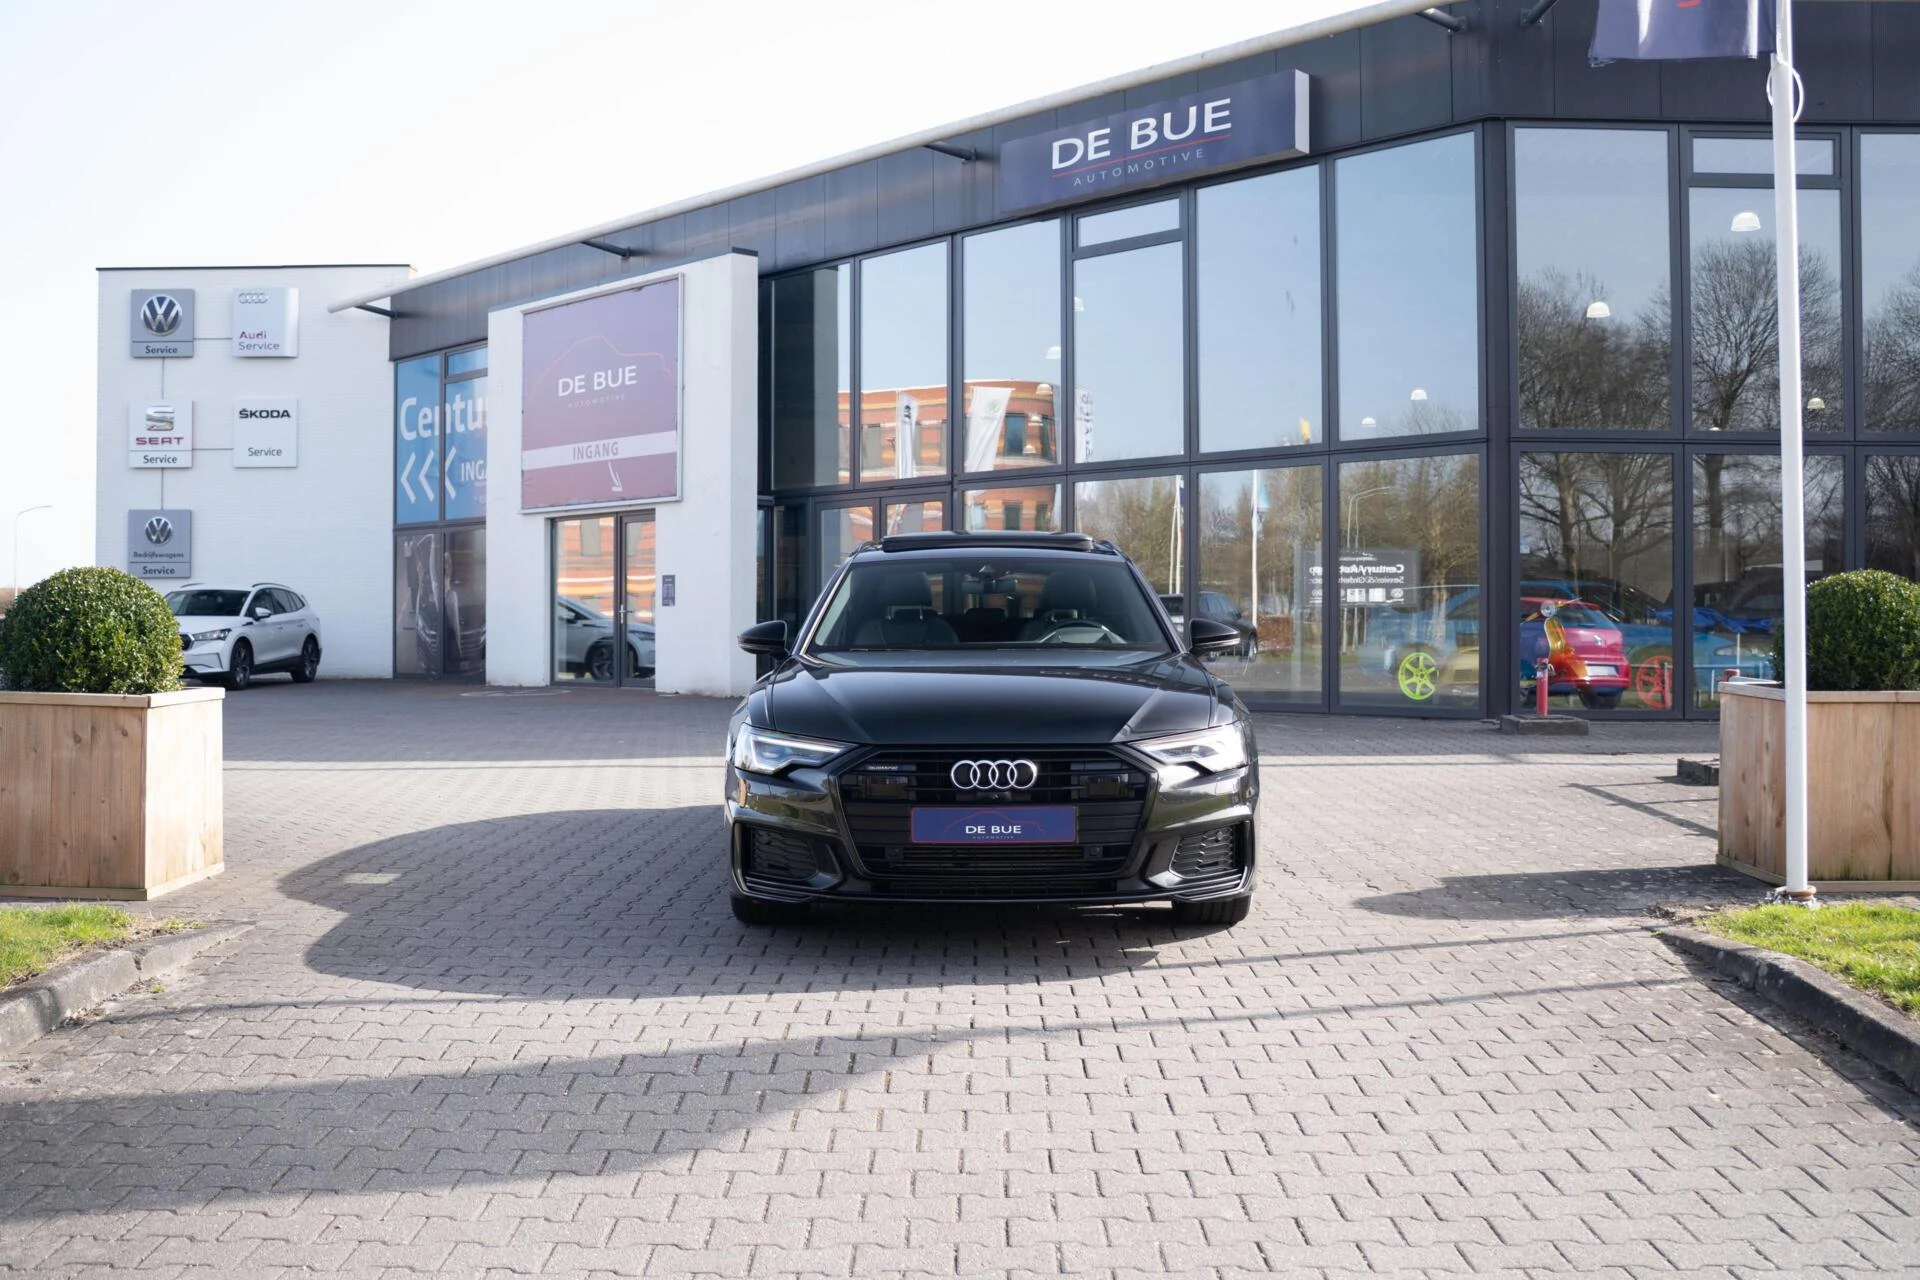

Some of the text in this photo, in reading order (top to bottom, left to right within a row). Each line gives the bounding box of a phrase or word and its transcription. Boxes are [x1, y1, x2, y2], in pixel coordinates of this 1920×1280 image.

[1052, 97, 1232, 171] DE BUE
[1073, 148, 1204, 186] AUTOMOTIVE
[239, 331, 267, 340] Audi
[145, 346, 178, 354] Service
[238, 342, 280, 351] Service
[558, 365, 638, 397] DE BUE
[239, 408, 291, 419] ŠKODA
[136, 437, 184, 445] SEAT
[248, 447, 282, 456] Service
[572, 441, 619, 461] INGANG
[143, 455, 178, 464] Service
[142, 566, 176, 575] Service
[965, 825, 1022, 834] DE BUE
